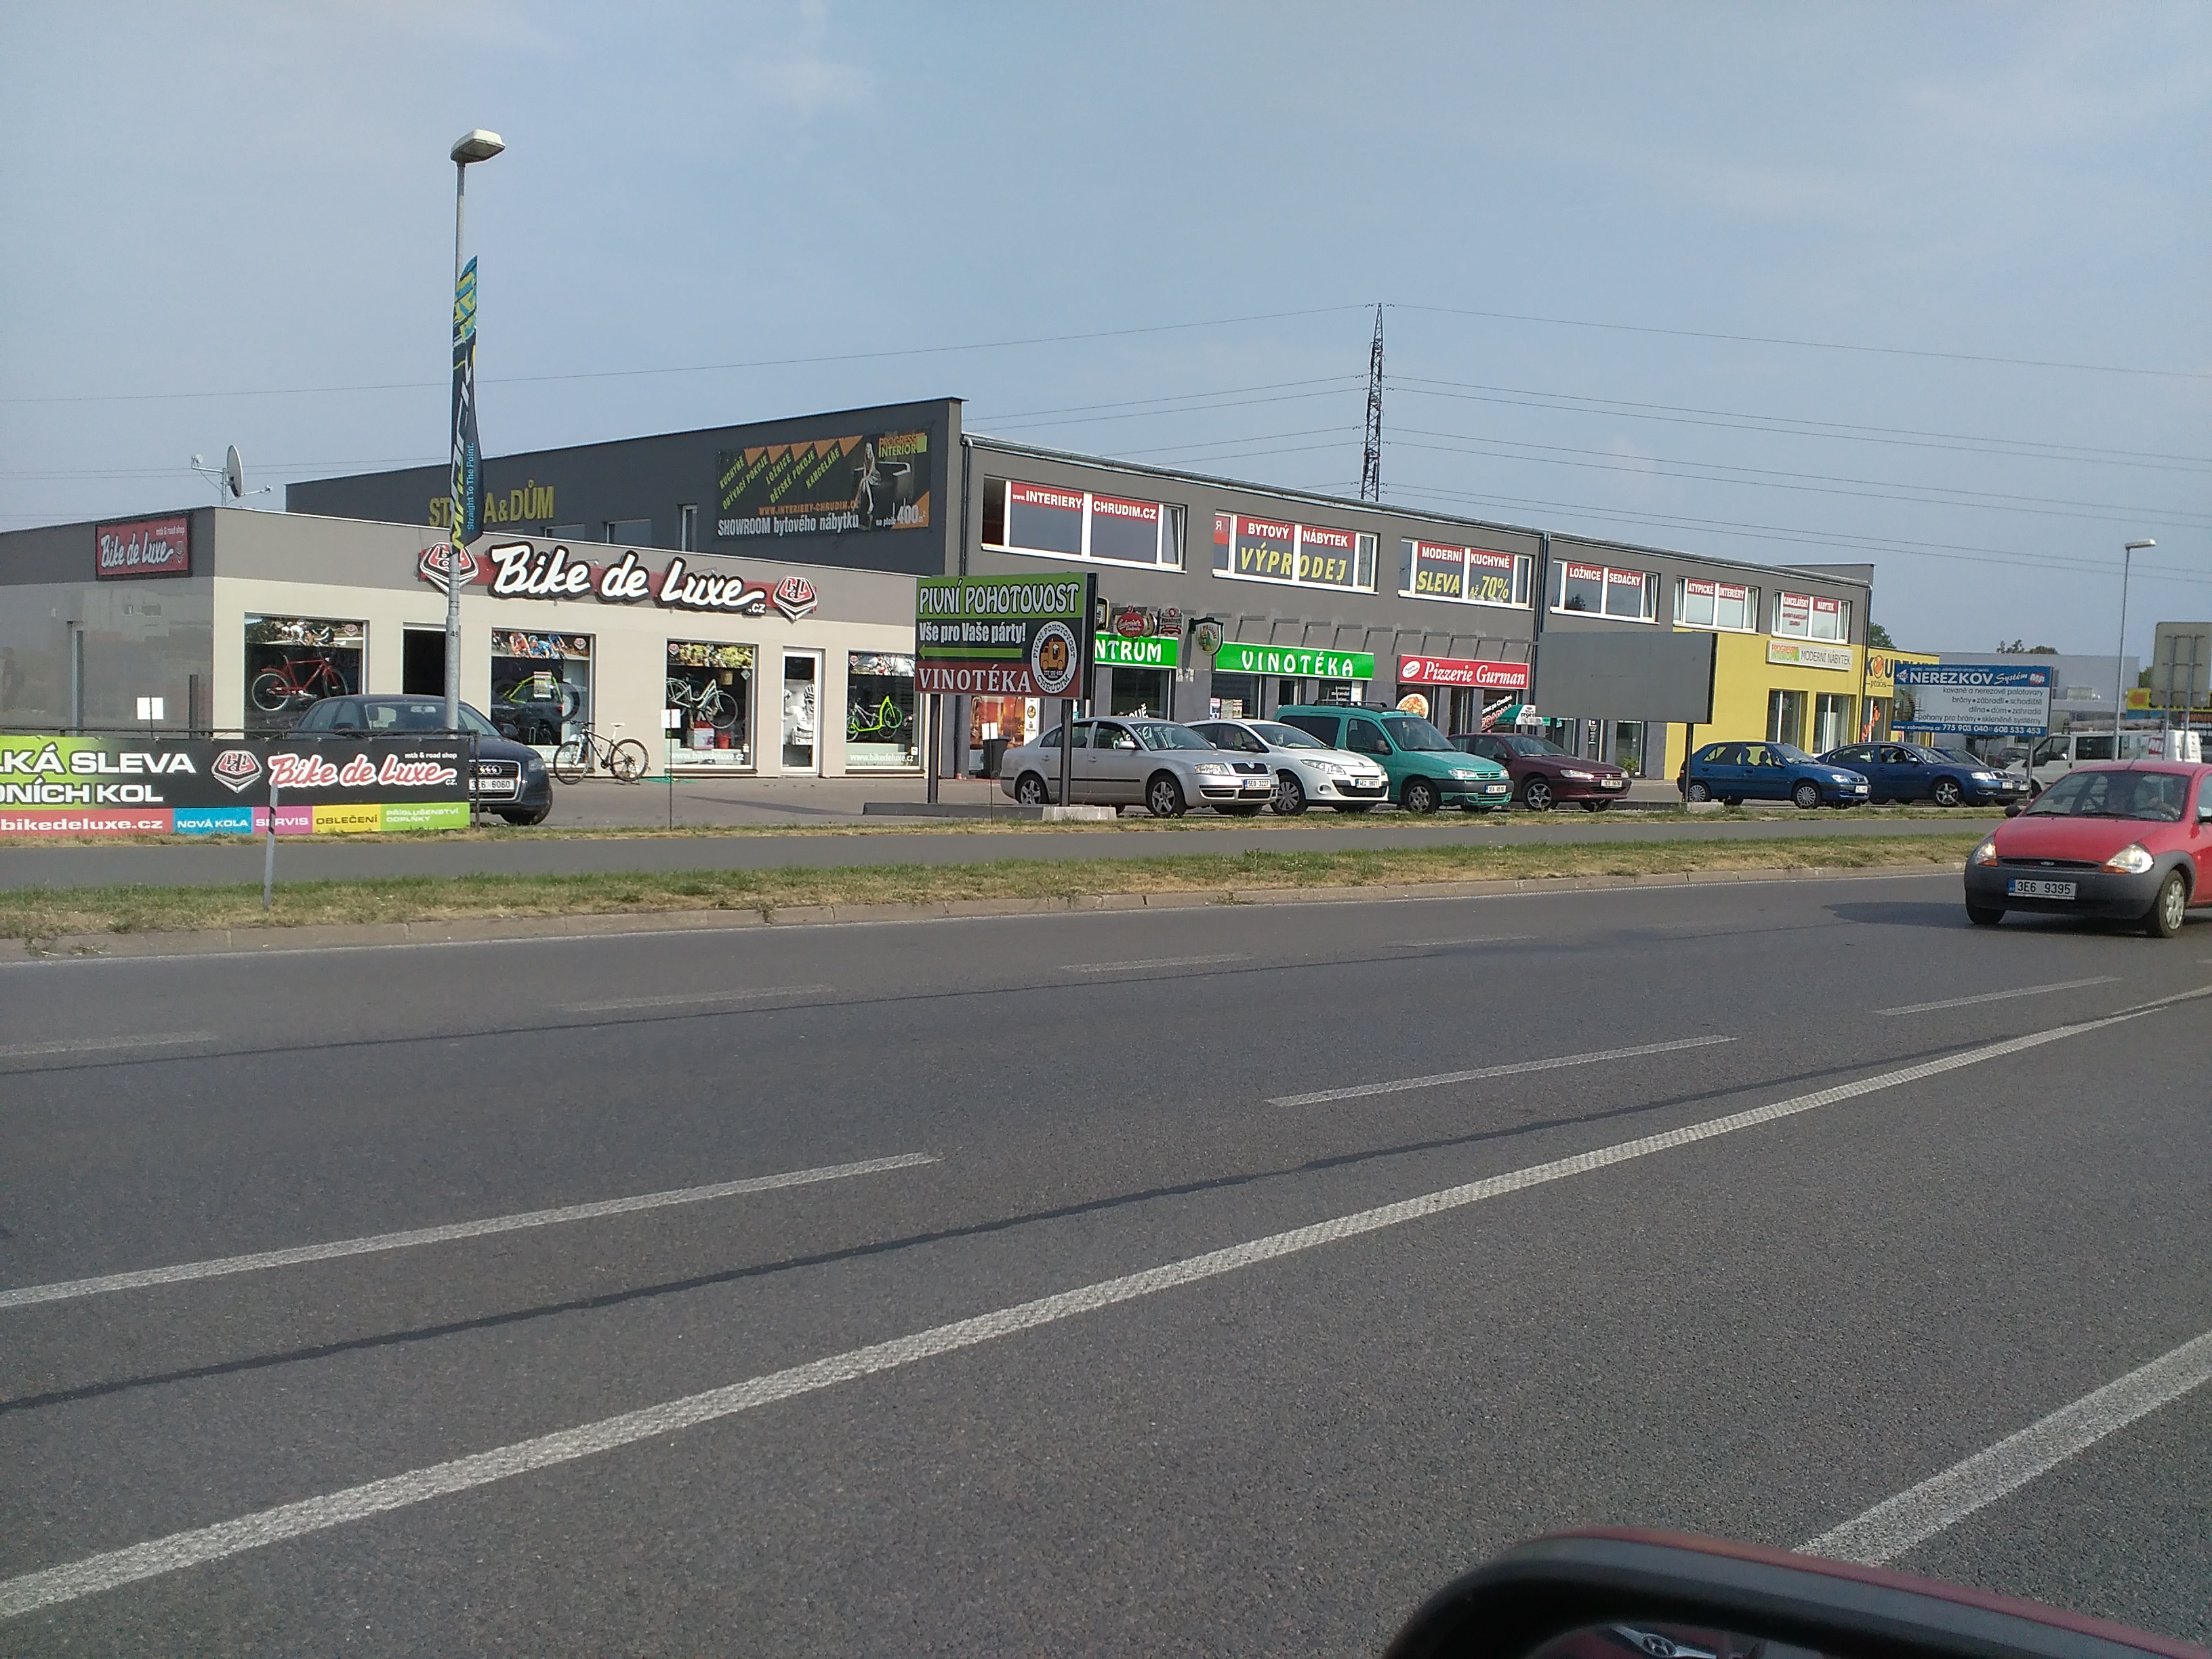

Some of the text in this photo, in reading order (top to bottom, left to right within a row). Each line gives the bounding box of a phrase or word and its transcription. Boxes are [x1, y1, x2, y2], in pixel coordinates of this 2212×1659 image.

[879, 444, 916, 457] INTERIOR
[746, 455, 769, 484] POKOJE
[792, 451, 815, 480] POKOJE
[806, 448, 840, 489] KANCELÁŘE
[466, 487, 474, 496] To
[466, 497, 475, 531] Straight
[718, 511, 859, 536] SHOWROOM bytového nábytku
[897, 504, 919, 524] 400
[1248, 523, 1348, 547] BYTOVÝ NÁBYTEK
[101, 531, 174, 568] Bike de Luxe
[1422, 546, 1511, 569] MODERNÍ KUCHYNĚ
[491, 544, 765, 607] Bike de Luxe
[1416, 571, 1510, 599] SLEVA AŽ 70%
[1569, 564, 1641, 587] LOŽNICE SEDAČKY
[919, 579, 1080, 614] PIVNÍ POHOTOVOST
[1687, 582, 1745, 600] ATYPICKÉ INTERIÉRY
[1783, 596, 1835, 611] KANCELÁŘSKÝ NÁBYTEK
[919, 621, 1027, 644] Vše pro Vaše párty!
[1044, 624, 1076, 658] POHOTOVOST
[1094, 638, 1162, 663] NTRUM
[1801, 650, 1826, 662] MODERNÍ
[1827, 651, 1851, 665] NÁBYTEK
[1242, 652, 1353, 677] VINOTÉKA
[1422, 661, 1525, 686] Pizzerie Gurman
[919, 664, 1032, 693] VINOTÉKA
[1037, 674, 1070, 692] CHRUDIM
[1910, 672, 1994, 685] NEREZKOV
[1993, 671, 2028, 685] Systém
[2007, 689, 2044, 697] polotovary
[1918, 714, 1943, 722] pohony
[0, 741, 197, 773] KÁ SLEVA
[441, 752, 457, 760] shop
[671, 750, 744, 762] www.bikedeluxe.cz
[849, 753, 914, 762] www.bikedeluxe.cz
[268, 753, 457, 788] Bike de Luxe
[0, 777, 163, 803] NÍCH KOL
[471, 780, 511, 789] 36 6060
[178, 818, 248, 828] NOVÁ KOLA
[316, 814, 377, 825] OBLEČENÍ
[386, 807, 459, 817] PŘÍSLUŠENSTVÍ
[386, 815, 432, 823] DOPLŇKY
[2017, 881, 2070, 895] 3E6 9395
